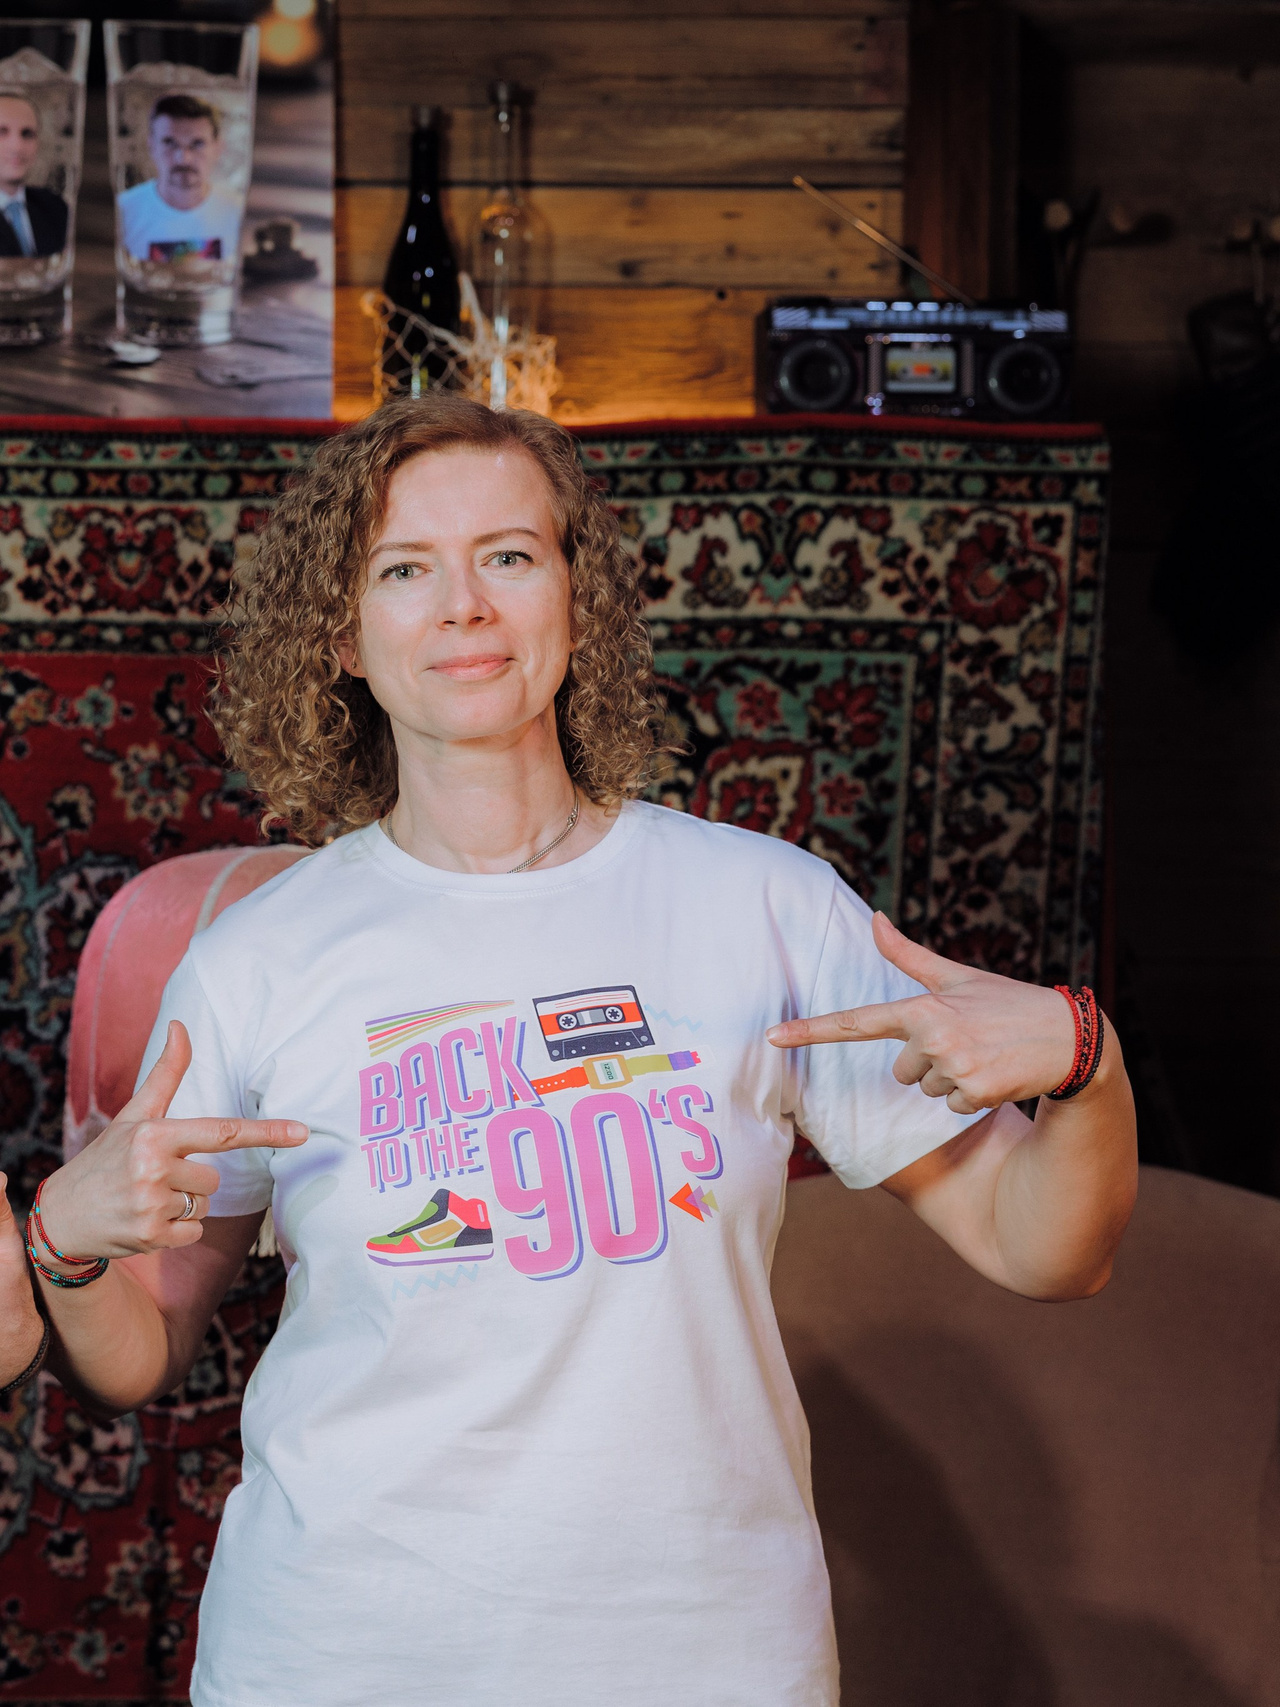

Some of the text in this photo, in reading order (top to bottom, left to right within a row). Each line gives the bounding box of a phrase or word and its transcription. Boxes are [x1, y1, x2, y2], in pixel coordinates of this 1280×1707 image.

[358, 1015, 544, 1141] BACK
[360, 1137, 413, 1194] TO
[409, 1121, 485, 1182] THE
